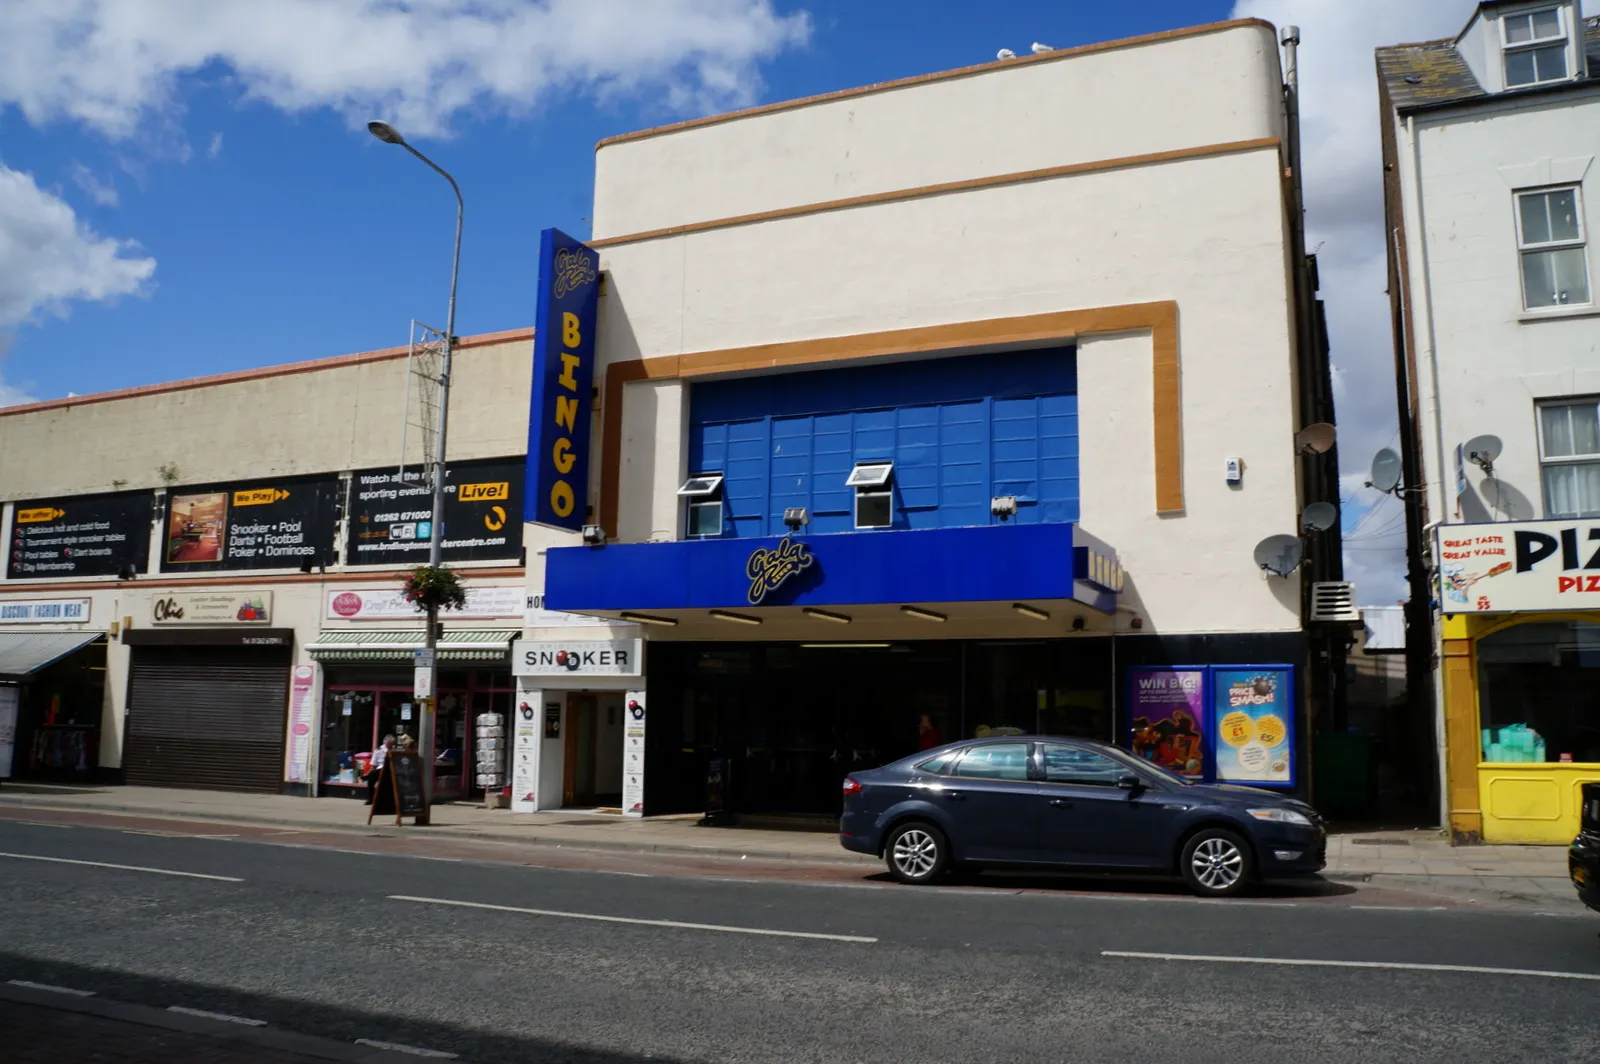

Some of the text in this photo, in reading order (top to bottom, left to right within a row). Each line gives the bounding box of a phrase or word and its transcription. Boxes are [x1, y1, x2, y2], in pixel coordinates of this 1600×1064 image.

[550, 311, 581, 518] BINGO
[360, 475, 390, 485] Watch
[391, 473, 403, 483] al
[404, 471, 420, 482] the
[236, 491, 273, 502] We Play
[359, 488, 398, 501] sporting
[461, 483, 505, 498] Live!
[230, 521, 302, 536] Snooker Pool
[229, 533, 304, 547] Darts Football
[1443, 536, 1504, 548] GREAT TASTE
[228, 545, 316, 558] Poker Dominoes
[1442, 547, 1507, 560] GREAT VALUE
[746, 537, 813, 593] Gala
[1477, 601, 1491, 610] 55
[1139, 678, 1197, 689] WIN BIG!
[1229, 686, 1255, 697] PRICE
[1230, 692, 1275, 707] SMASH!
